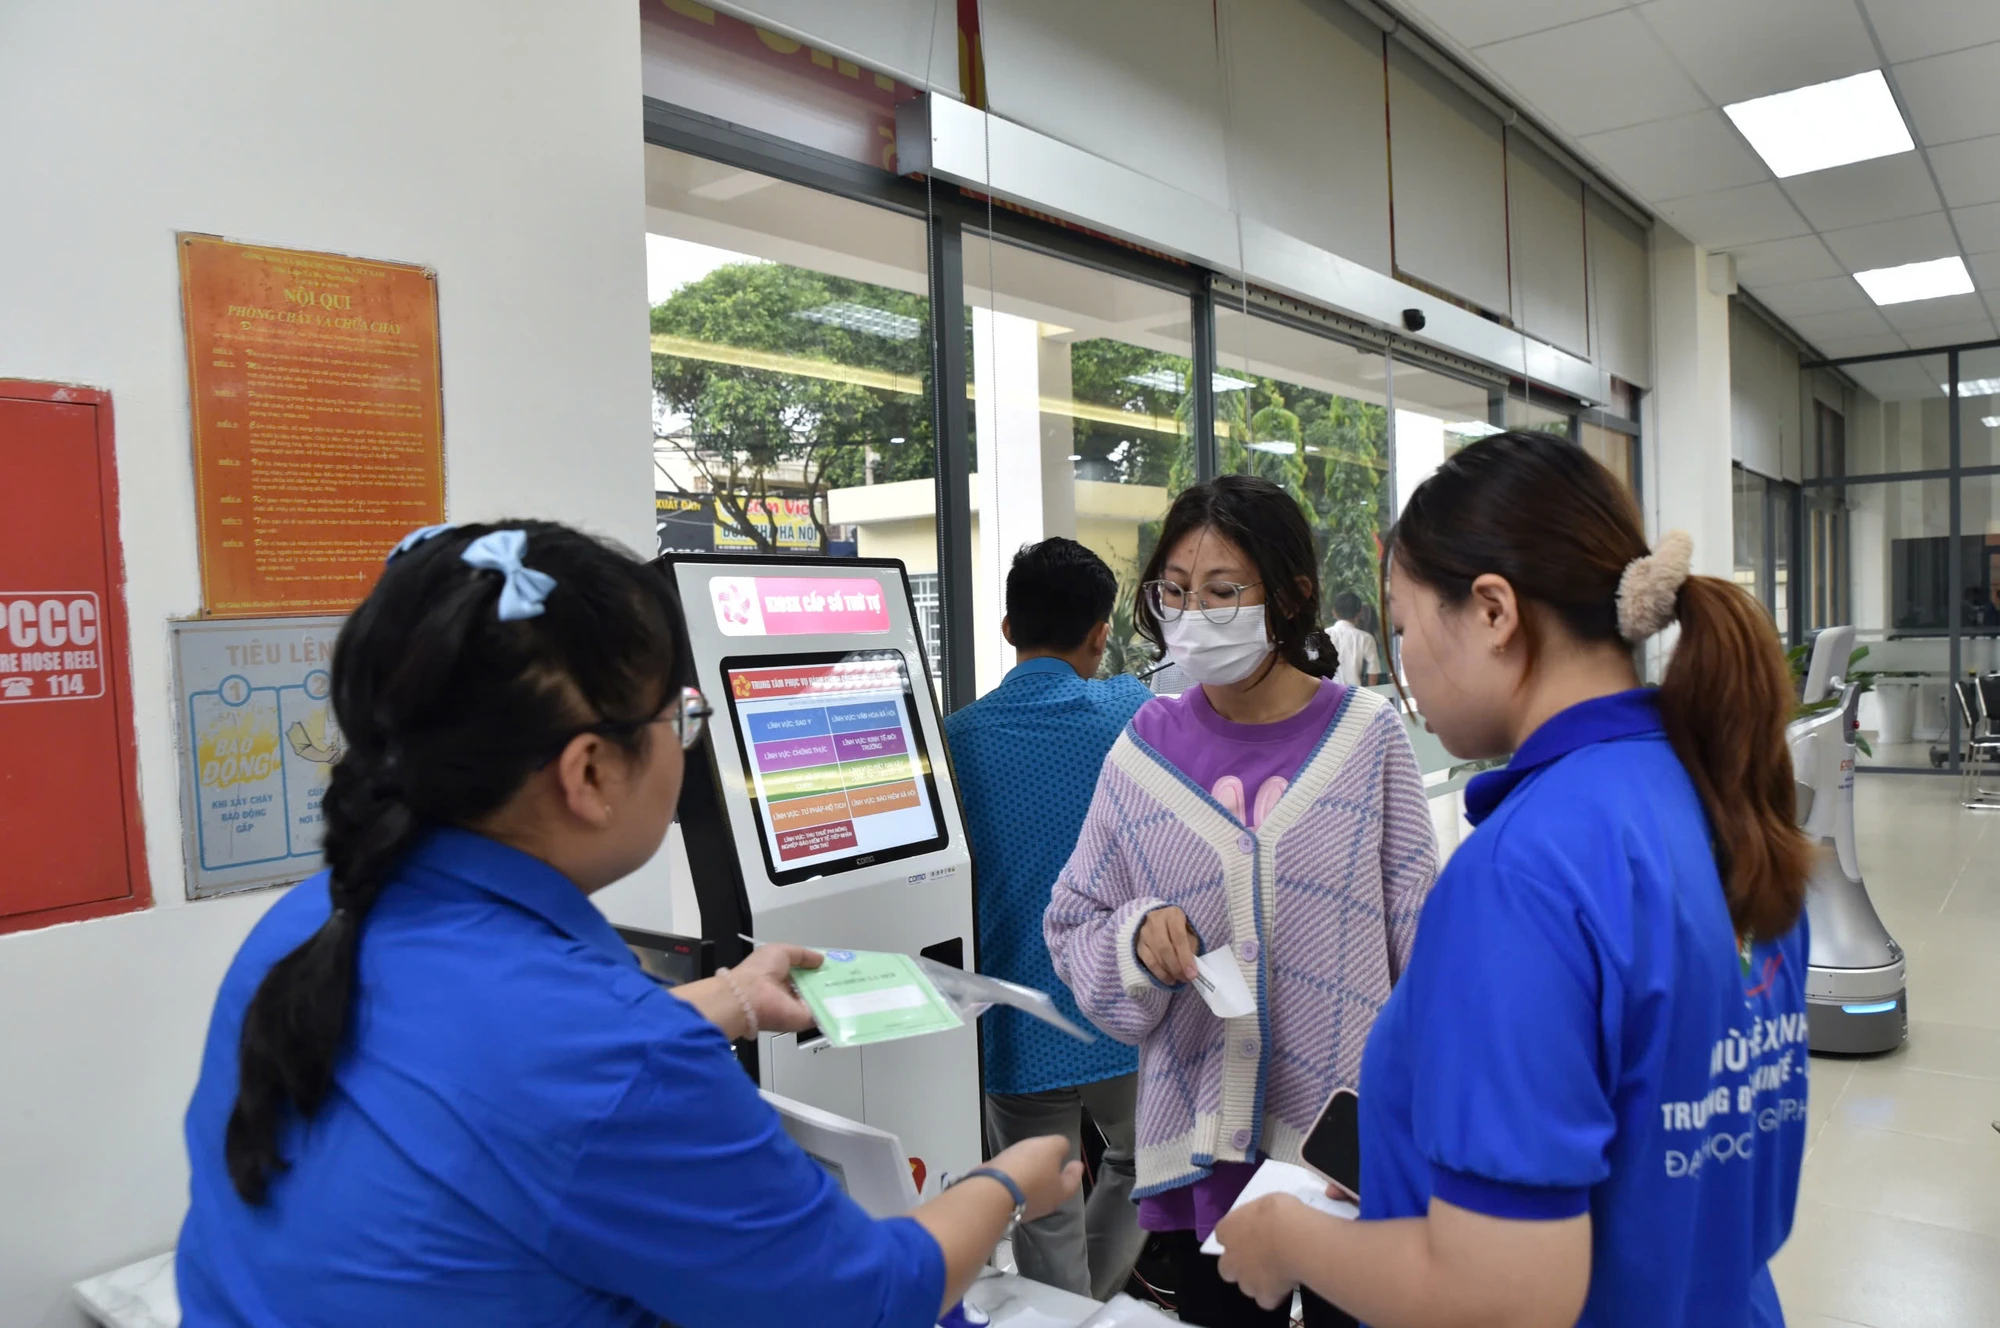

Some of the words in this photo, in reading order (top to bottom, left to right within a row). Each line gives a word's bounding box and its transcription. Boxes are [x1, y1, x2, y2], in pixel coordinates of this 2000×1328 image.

[283, 286, 315, 307] NỘI
[320, 293, 351, 311] QUI
[0, 599, 97, 648] CCC
[21, 651, 61, 672] HOSE
[63, 650, 97, 670] REEL
[225, 639, 281, 667] TIÊU
[289, 637, 333, 667] LỆN
[46, 673, 85, 696] 114
[230, 681, 241, 702] 1
[311, 675, 327, 696] 2
[751, 680, 771, 690] TRUNG
[212, 800, 227, 809] KHI
